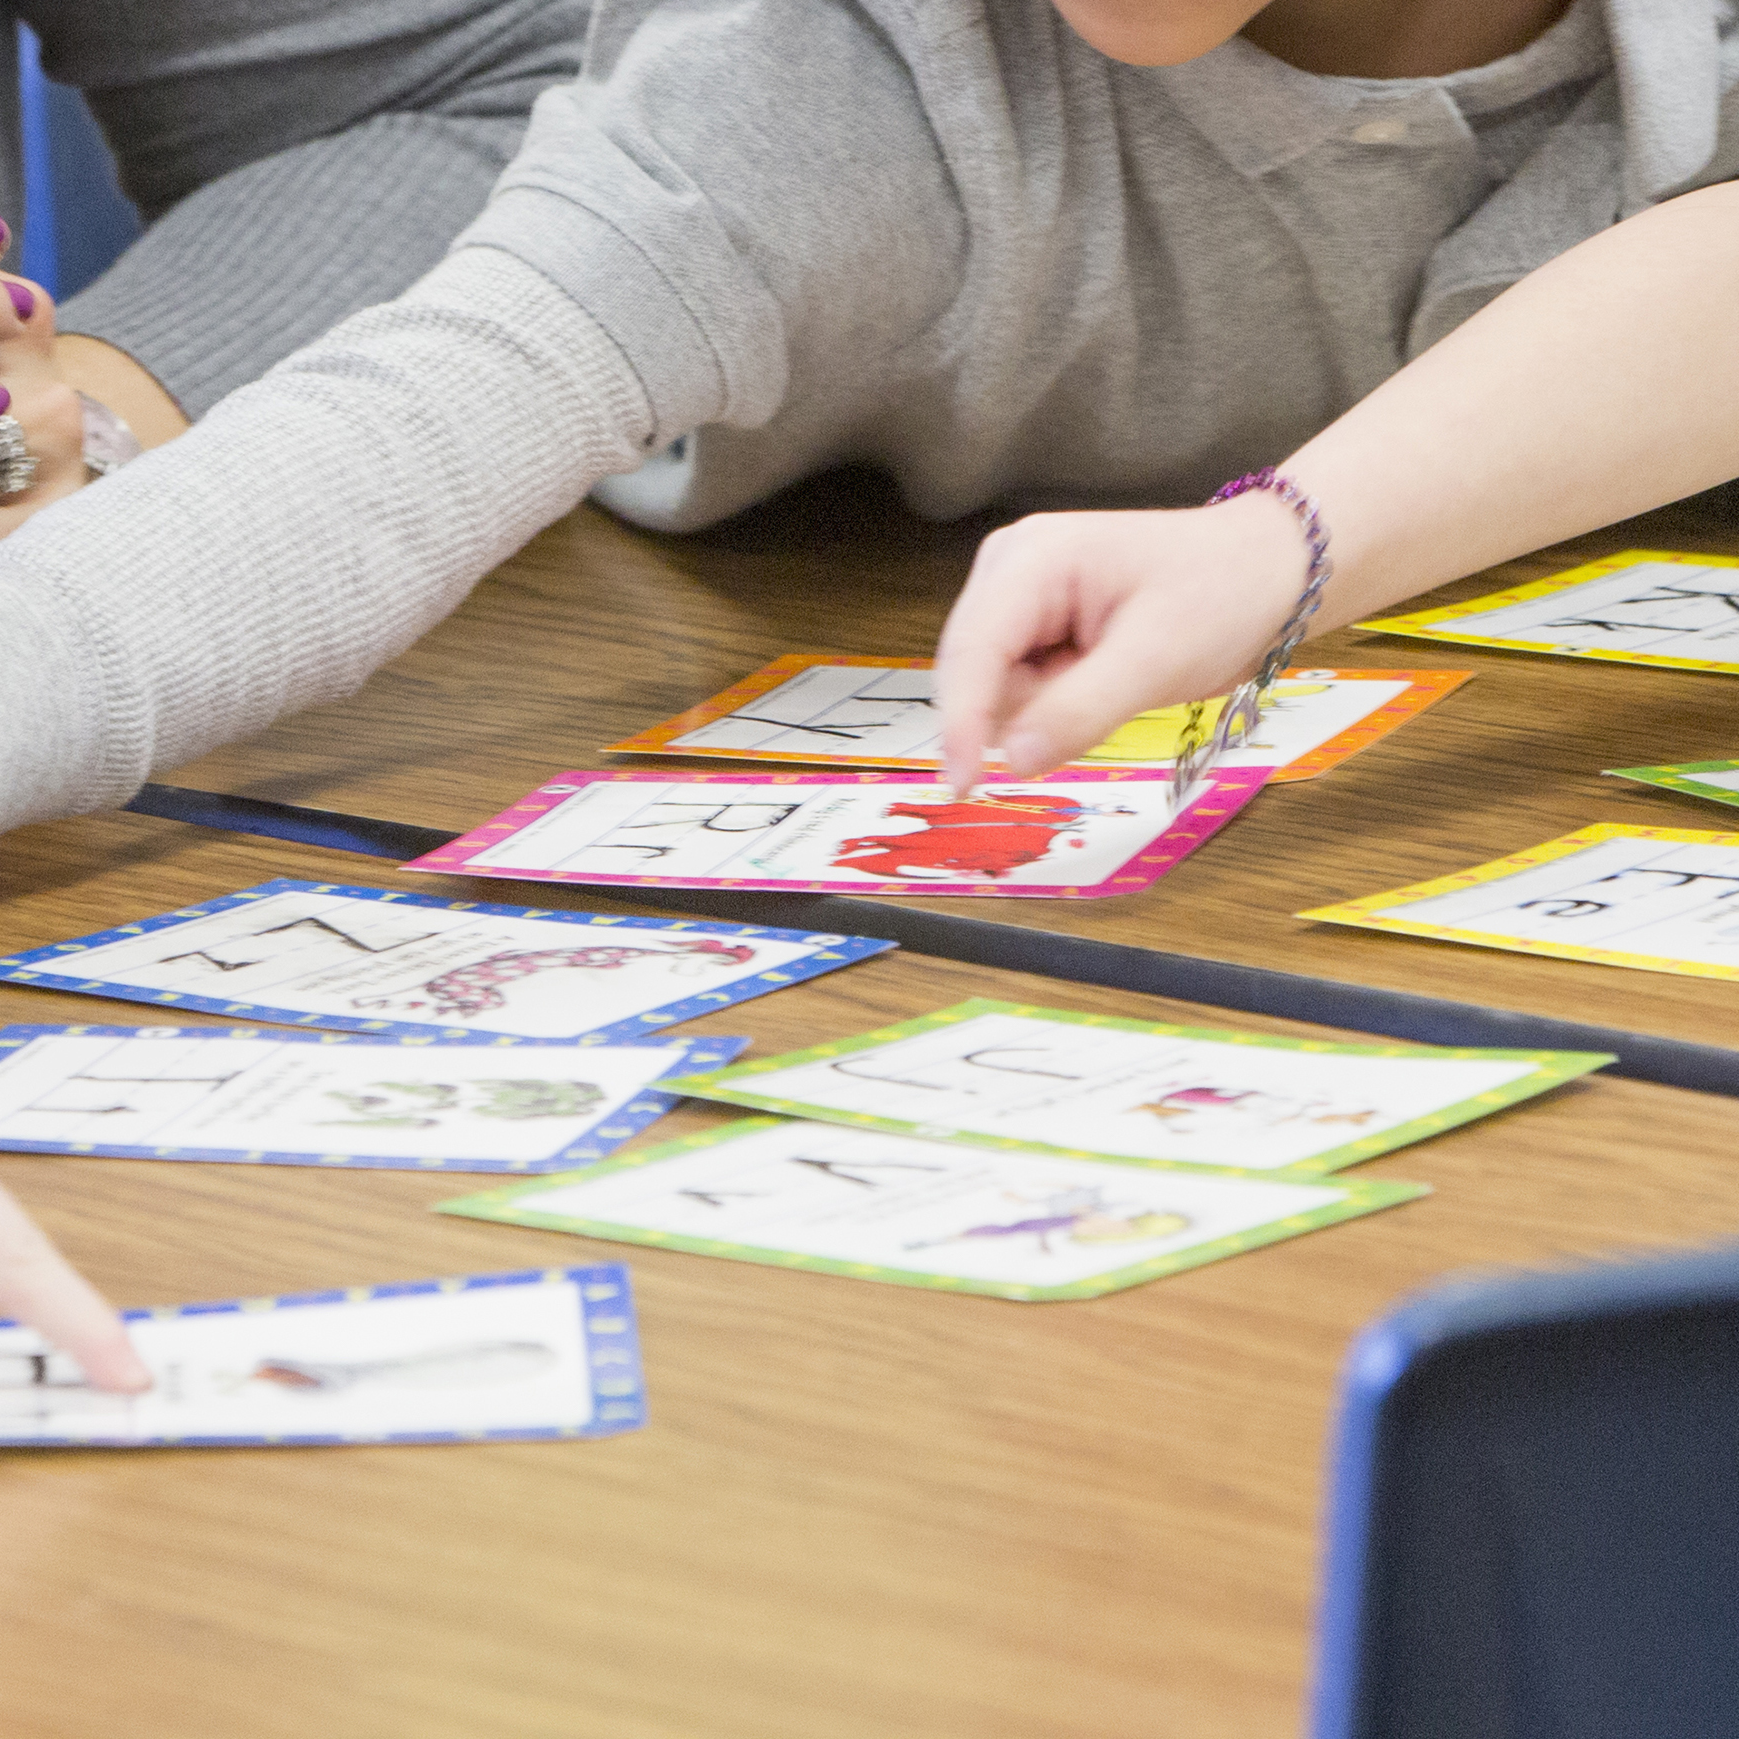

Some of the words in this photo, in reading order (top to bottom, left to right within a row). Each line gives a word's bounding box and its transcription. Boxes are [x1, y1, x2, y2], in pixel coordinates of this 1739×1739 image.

[1542, 617, 1700, 631] k
[727, 715, 892, 739] y
[618, 803, 802, 832] R
[585, 844, 677, 858] r
[1517, 899, 1611, 918] e
[252, 917, 441, 952] Z
[158, 951, 264, 971] z
[830, 1055, 978, 1095] j
[962, 1048, 1083, 1080] J
